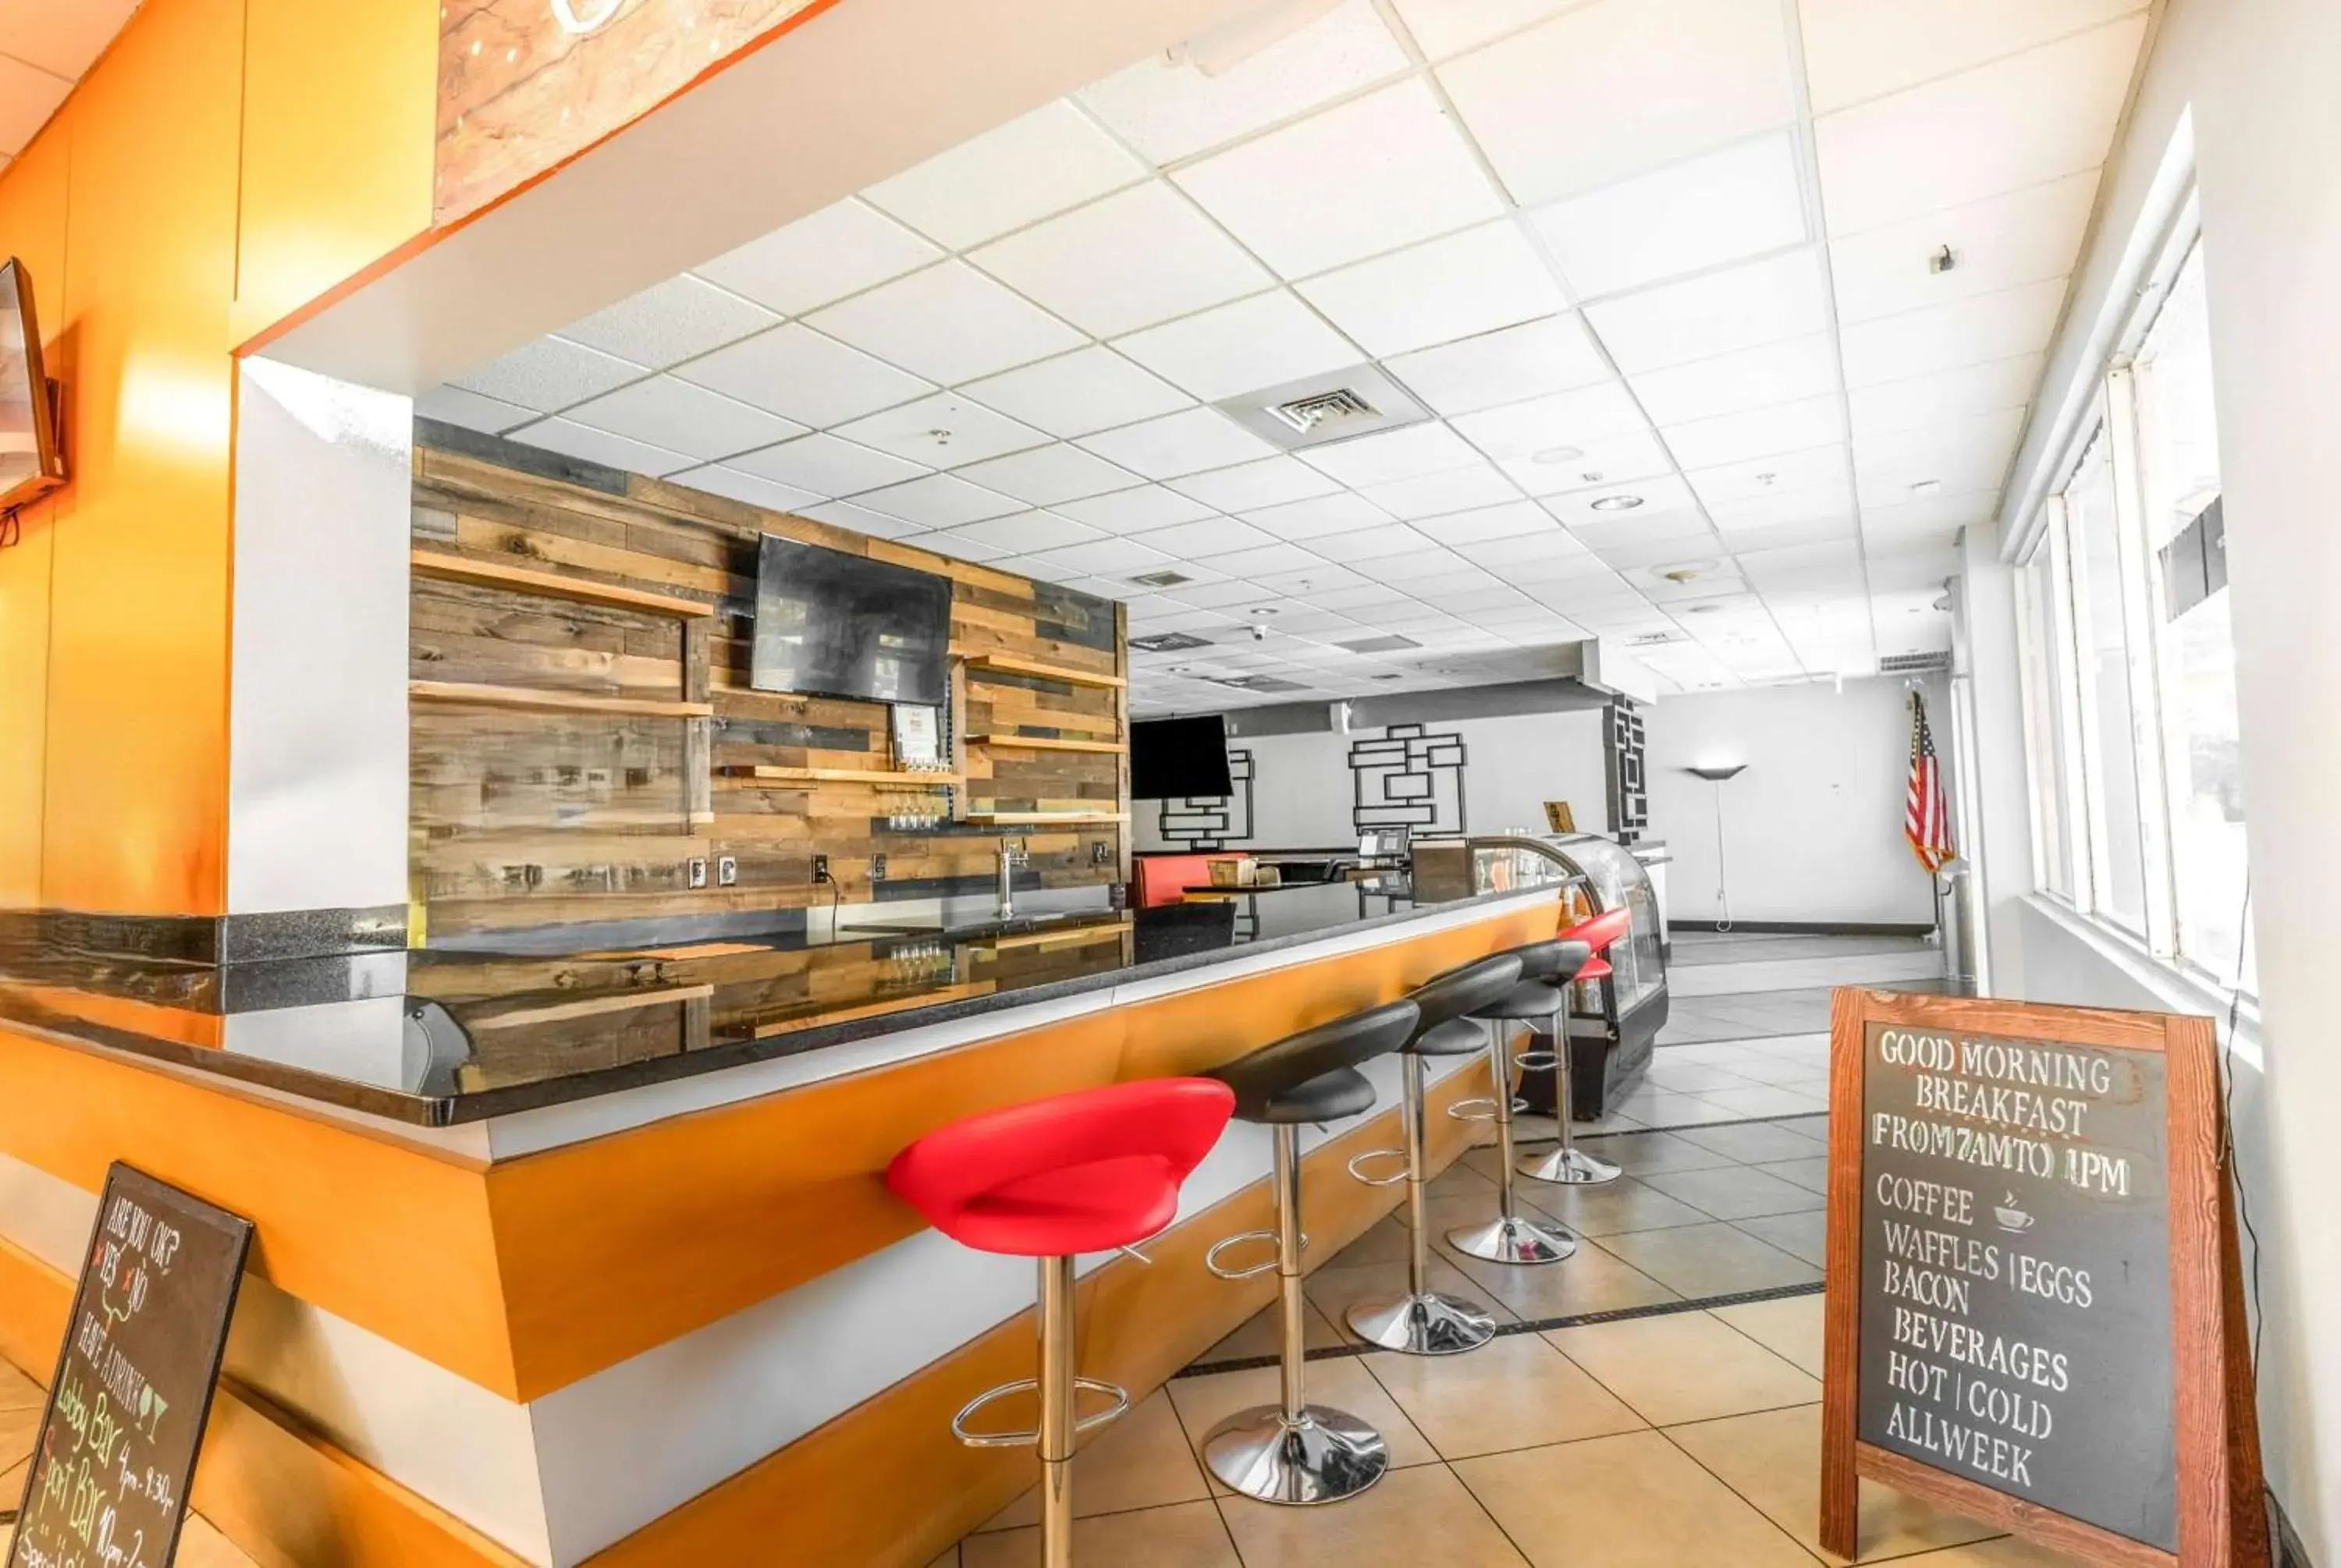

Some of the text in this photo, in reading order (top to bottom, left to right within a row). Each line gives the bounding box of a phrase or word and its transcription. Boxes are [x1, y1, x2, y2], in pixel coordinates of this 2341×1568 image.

[1881, 1031, 2110, 1094] GOOD MORNING
[1916, 1074, 2087, 1137] BREAKFAST
[1877, 1172, 1974, 1226] COFFEE
[1882, 1219, 1999, 1280] WAFFLES
[2020, 1255, 2093, 1308] EGGS
[1884, 1260, 1970, 1317] BACON
[1893, 1306, 2069, 1392] BEVERAGES
[58, 1357, 90, 1453] Lobby
[88, 1392, 123, 1470] Bar
[1888, 1350, 1948, 1403] HOT
[1969, 1380, 2052, 1440] COLD
[69, 1457, 107, 1548] Bar
